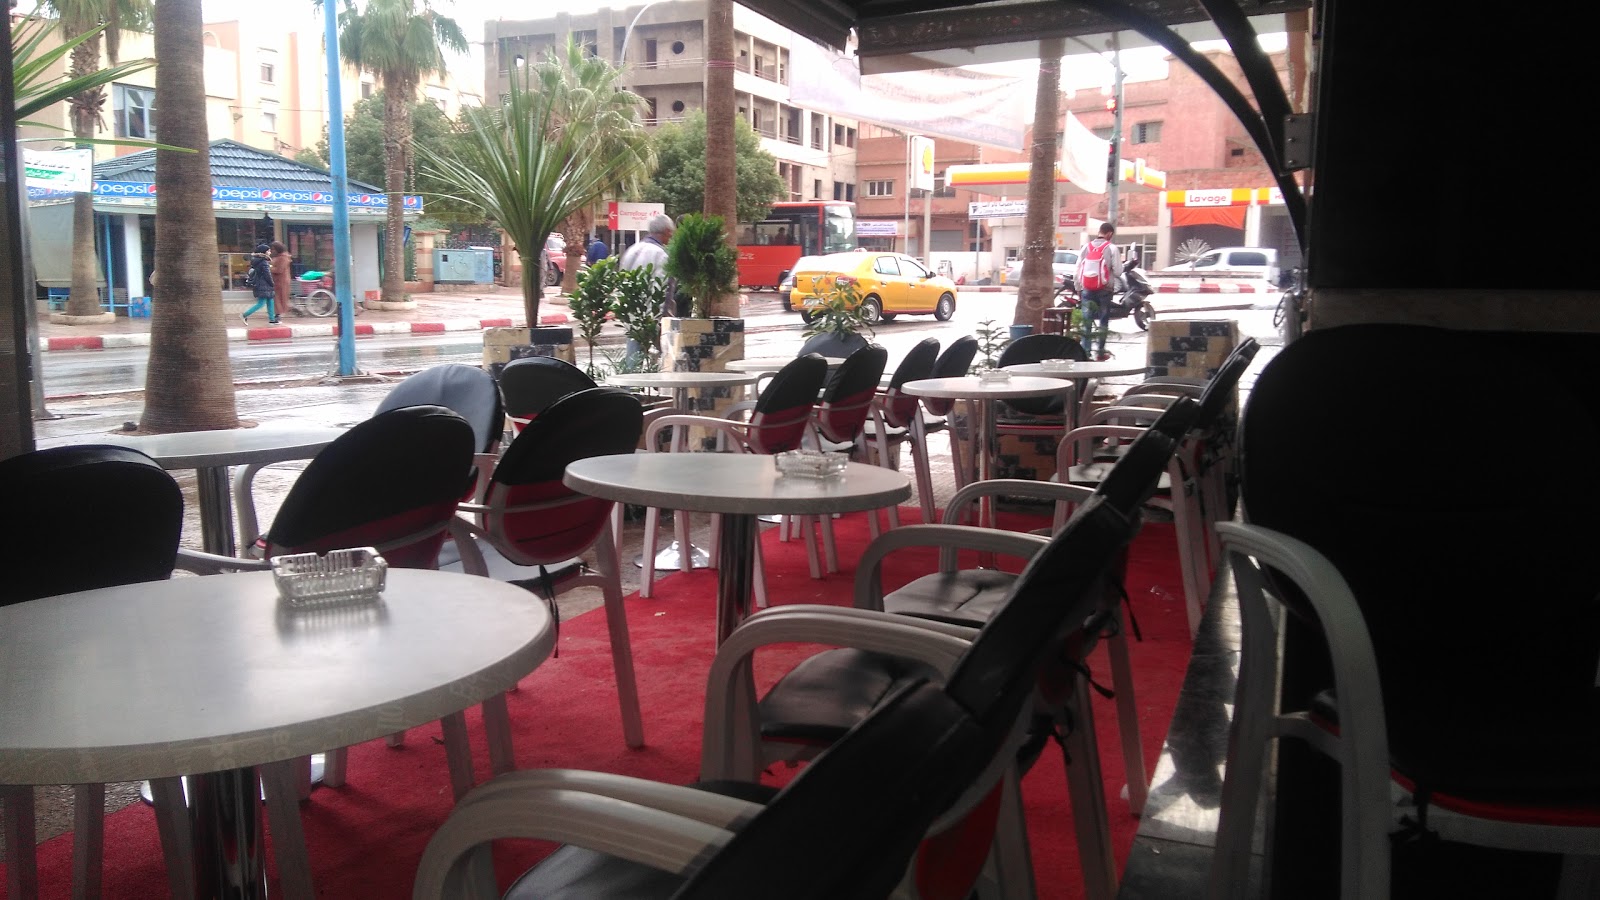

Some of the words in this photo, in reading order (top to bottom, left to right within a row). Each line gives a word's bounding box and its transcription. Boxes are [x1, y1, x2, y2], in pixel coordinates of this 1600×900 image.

[100, 184, 148, 196] pepsi
[219, 188, 261, 200] pepsi
[272, 191, 313, 202] pepsi
[1189, 194, 1227, 204] Lavage
